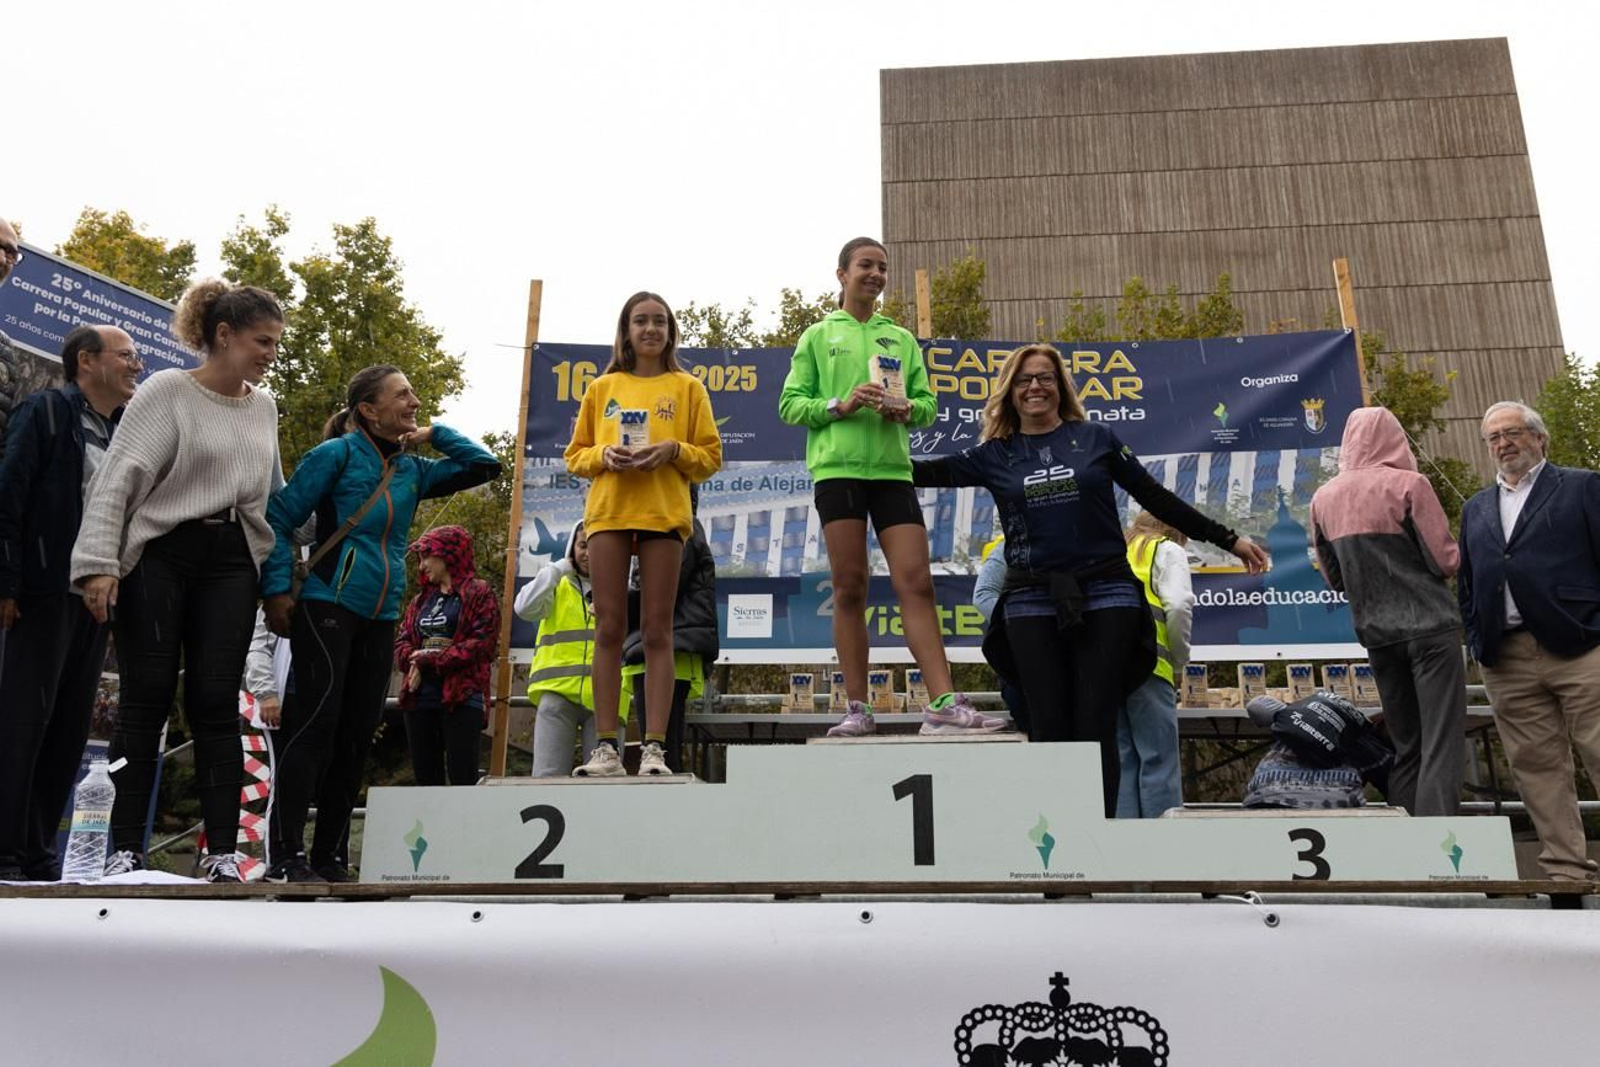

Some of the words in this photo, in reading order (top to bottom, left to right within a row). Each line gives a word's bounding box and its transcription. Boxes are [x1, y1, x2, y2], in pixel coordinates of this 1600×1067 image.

[11, 276, 62, 304] Carrera
[63, 297, 113, 323] Popular
[123, 321, 152, 339] Gran
[34, 302, 56, 317] por
[57, 310, 70, 322] la
[72, 315, 91, 327] Pa
[82, 289, 152, 325] Aniversario
[153, 318, 168, 331] de
[4, 314, 17, 325] 25
[18, 320, 42, 335] años
[552, 361, 597, 402] 16
[692, 365, 758, 392] 2025
[1241, 374, 1299, 388] Organiza
[621, 411, 648, 424] XXV
[951, 423, 973, 441] la
[550, 474, 580, 490] IES
[730, 476, 754, 491] de
[1023, 464, 1075, 486] 25
[792, 675, 812, 685] XXV
[869, 673, 888, 684] XXV
[1290, 666, 1311, 677] XXV
[892, 774, 935, 866] 1
[514, 804, 566, 879] 2
[1287, 828, 1331, 881] 3
[1043, 871, 1074, 879] Municipal
